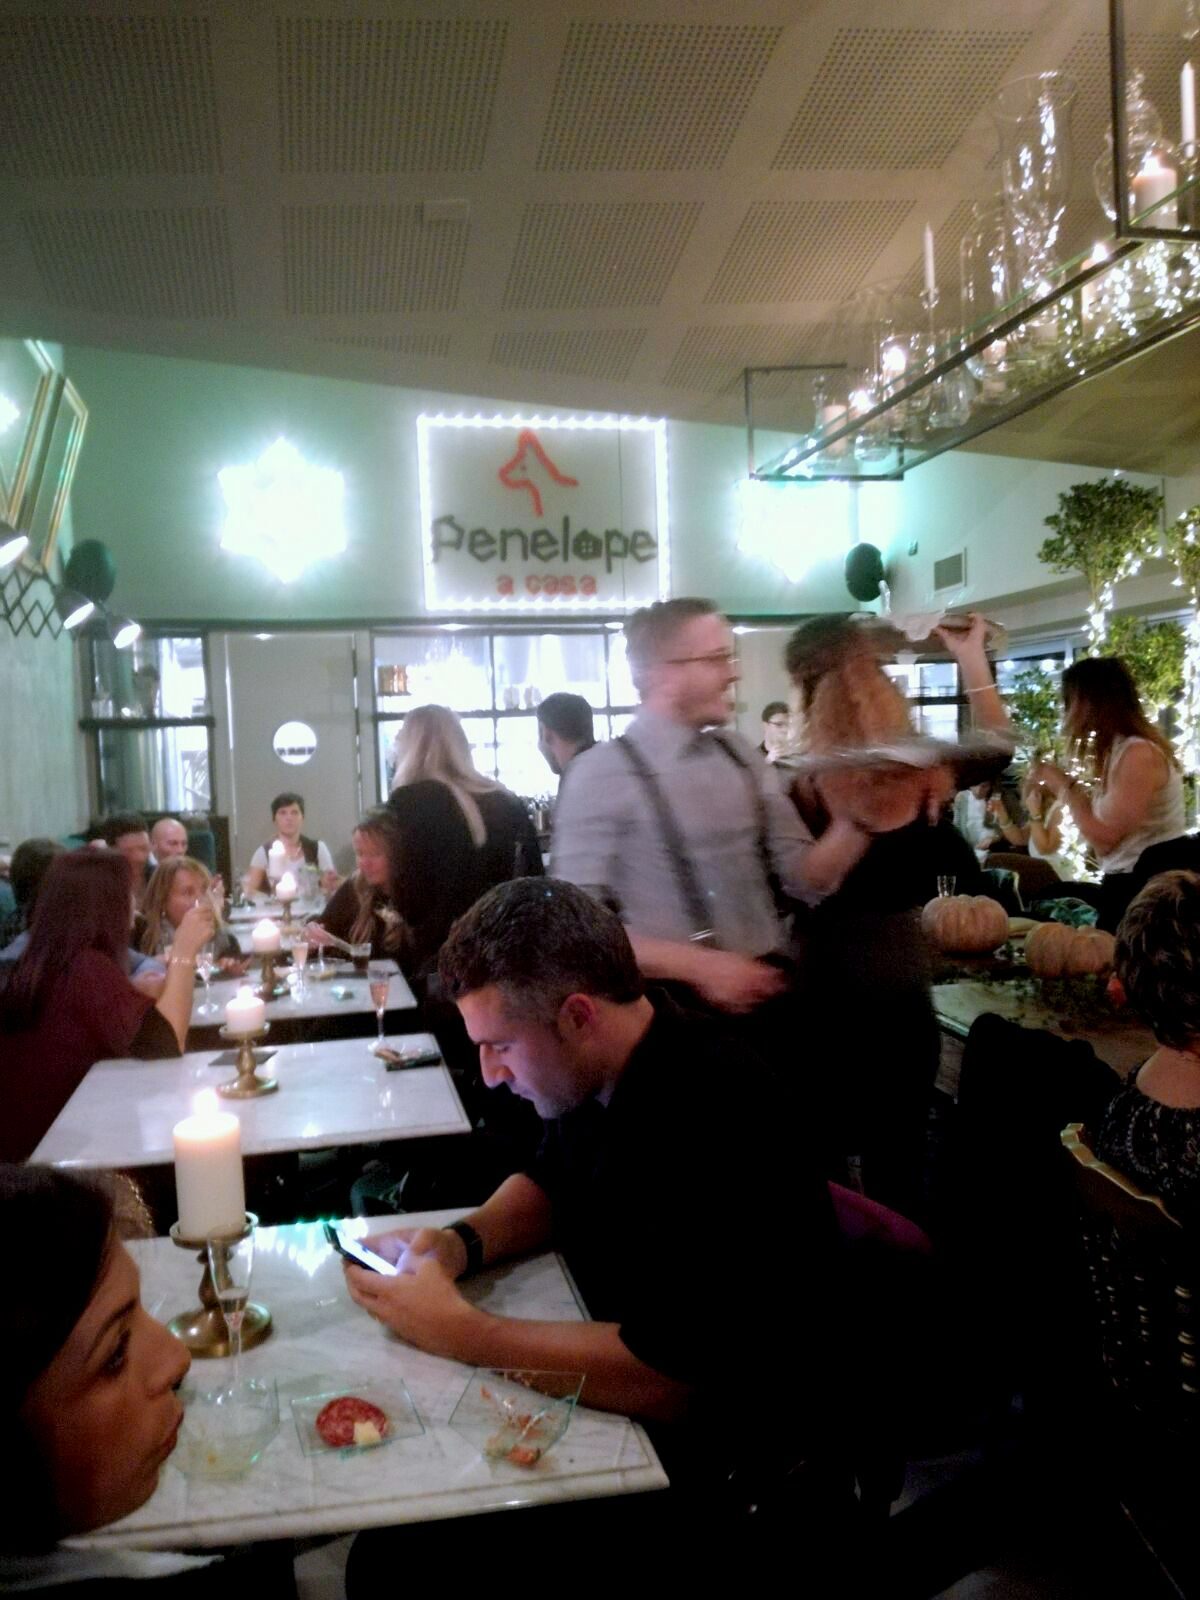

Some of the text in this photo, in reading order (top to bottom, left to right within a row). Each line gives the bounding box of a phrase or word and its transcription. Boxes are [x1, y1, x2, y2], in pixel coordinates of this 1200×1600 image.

[432, 514, 658, 574] Penelope
[497, 574, 596, 596] a casa
